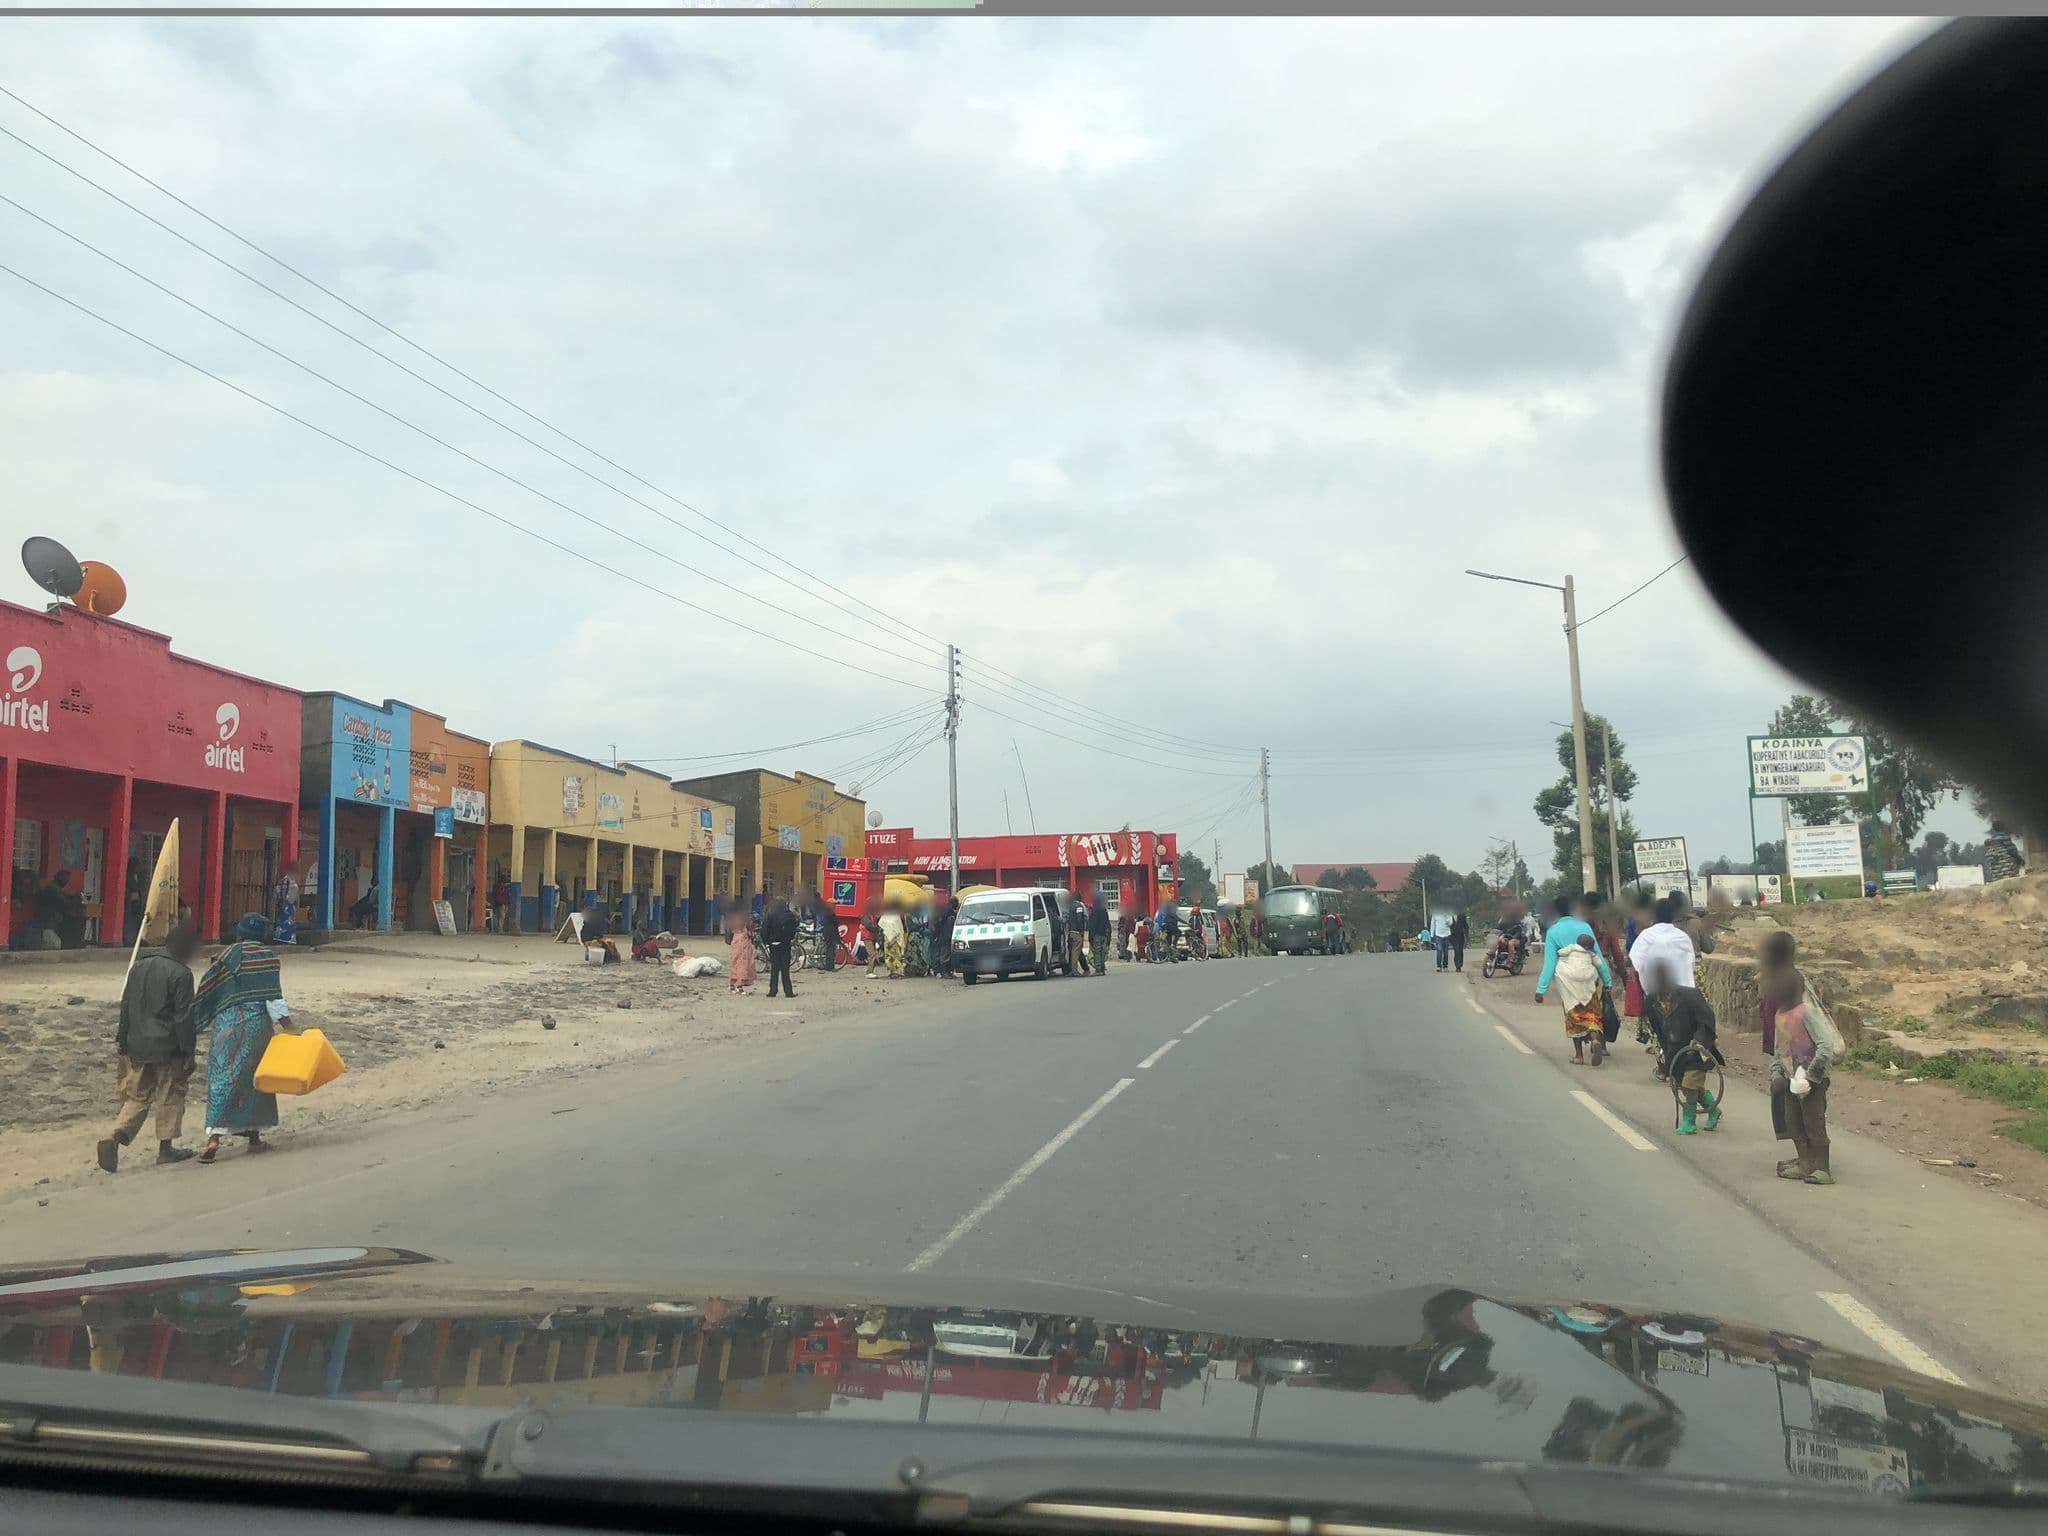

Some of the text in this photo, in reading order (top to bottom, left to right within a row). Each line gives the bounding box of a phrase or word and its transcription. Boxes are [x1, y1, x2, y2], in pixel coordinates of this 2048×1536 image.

[0, 692, 49, 732] irtel
[1762, 739, 1823, 749] KOAINYA
[205, 740, 245, 773] airtel
[1648, 840, 1677, 850] ADEPR
